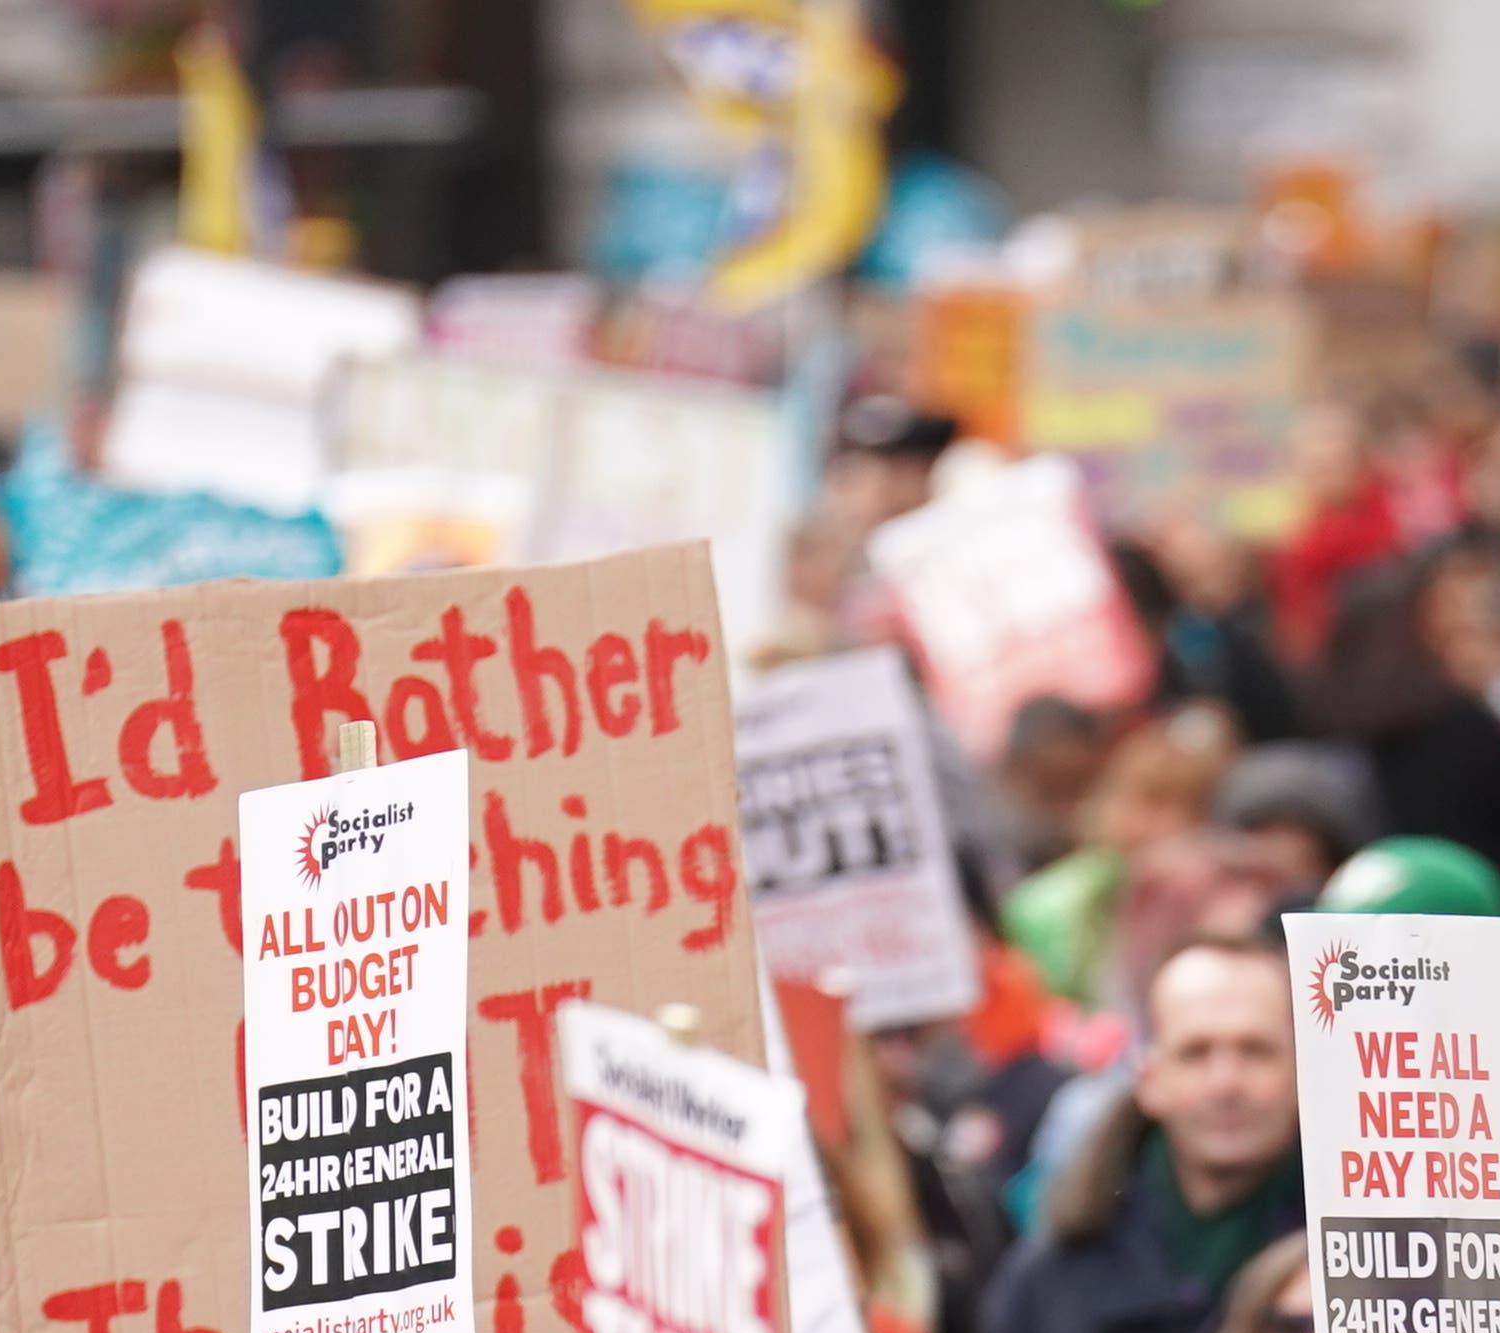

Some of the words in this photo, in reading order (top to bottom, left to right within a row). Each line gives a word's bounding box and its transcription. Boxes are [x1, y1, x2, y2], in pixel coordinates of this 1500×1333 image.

[278, 584, 709, 783] Rather
[328, 802, 415, 839] Socialist
[259, 910, 325, 962] ALL
[333, 891, 396, 947] OUT
[401, 880, 449, 931] ON
[290, 944, 419, 1014] BUDGET
[1340, 951, 1450, 982] Socialist
[327, 1007, 398, 1067] DAY!
[1354, 1030, 1420, 1080] WE
[1430, 1032, 1490, 1081] ALL
[261, 1085, 358, 1145] BUILD
[365, 1074, 423, 1124] FOR
[425, 1066, 452, 1114] A
[1357, 1091, 1461, 1141] NEED
[1468, 1093, 1493, 1141] A
[261, 1154, 341, 1203] 24HR
[342, 1132, 454, 1189] GENERAL
[1340, 1149, 1415, 1199] PAY
[263, 1188, 454, 1293] STRIKE
[1325, 1229, 1438, 1280] BUILD
